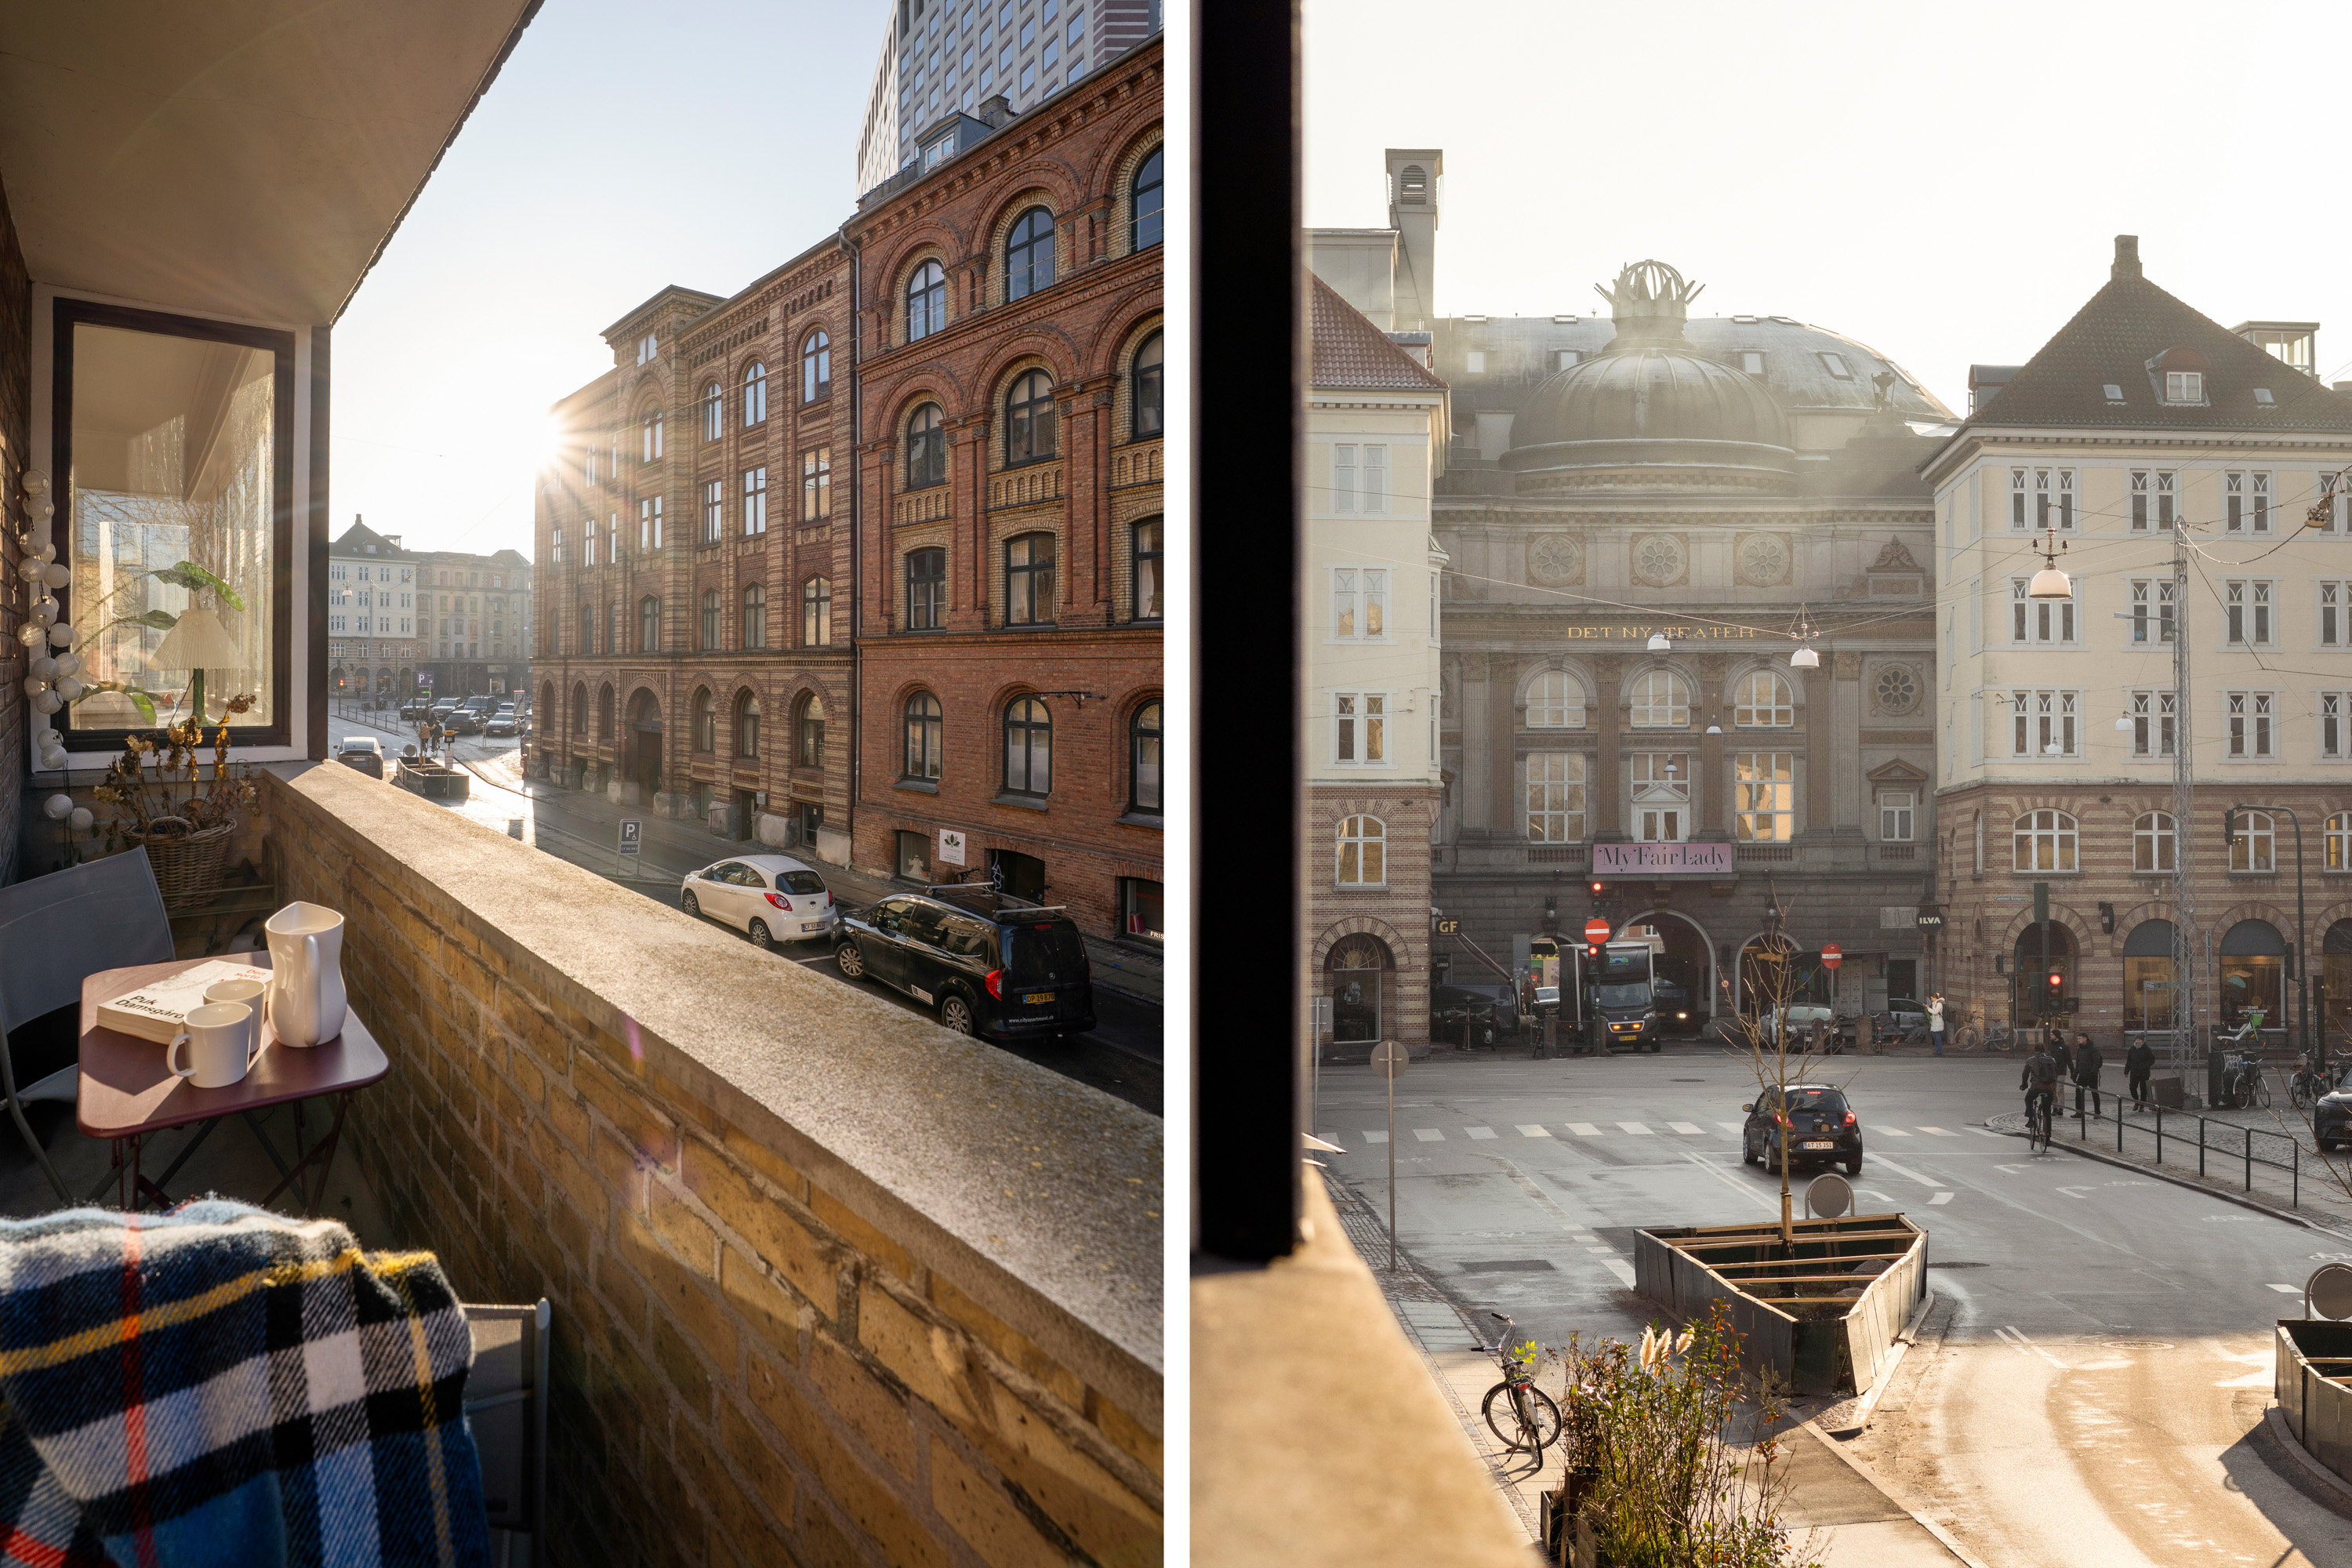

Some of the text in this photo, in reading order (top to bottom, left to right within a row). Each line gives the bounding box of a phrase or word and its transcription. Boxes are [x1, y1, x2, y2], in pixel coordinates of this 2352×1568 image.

[1568, 627, 1754, 638] DET NY TEATER
[419, 674, 425, 684] P
[626, 823, 636, 837] P
[1599, 847, 1727, 872] My Fair Lady
[1439, 921, 1457, 933] GF
[129, 995, 158, 1005] Puk
[1008, 1014, 1054, 1023] www.cityapartment.dk
